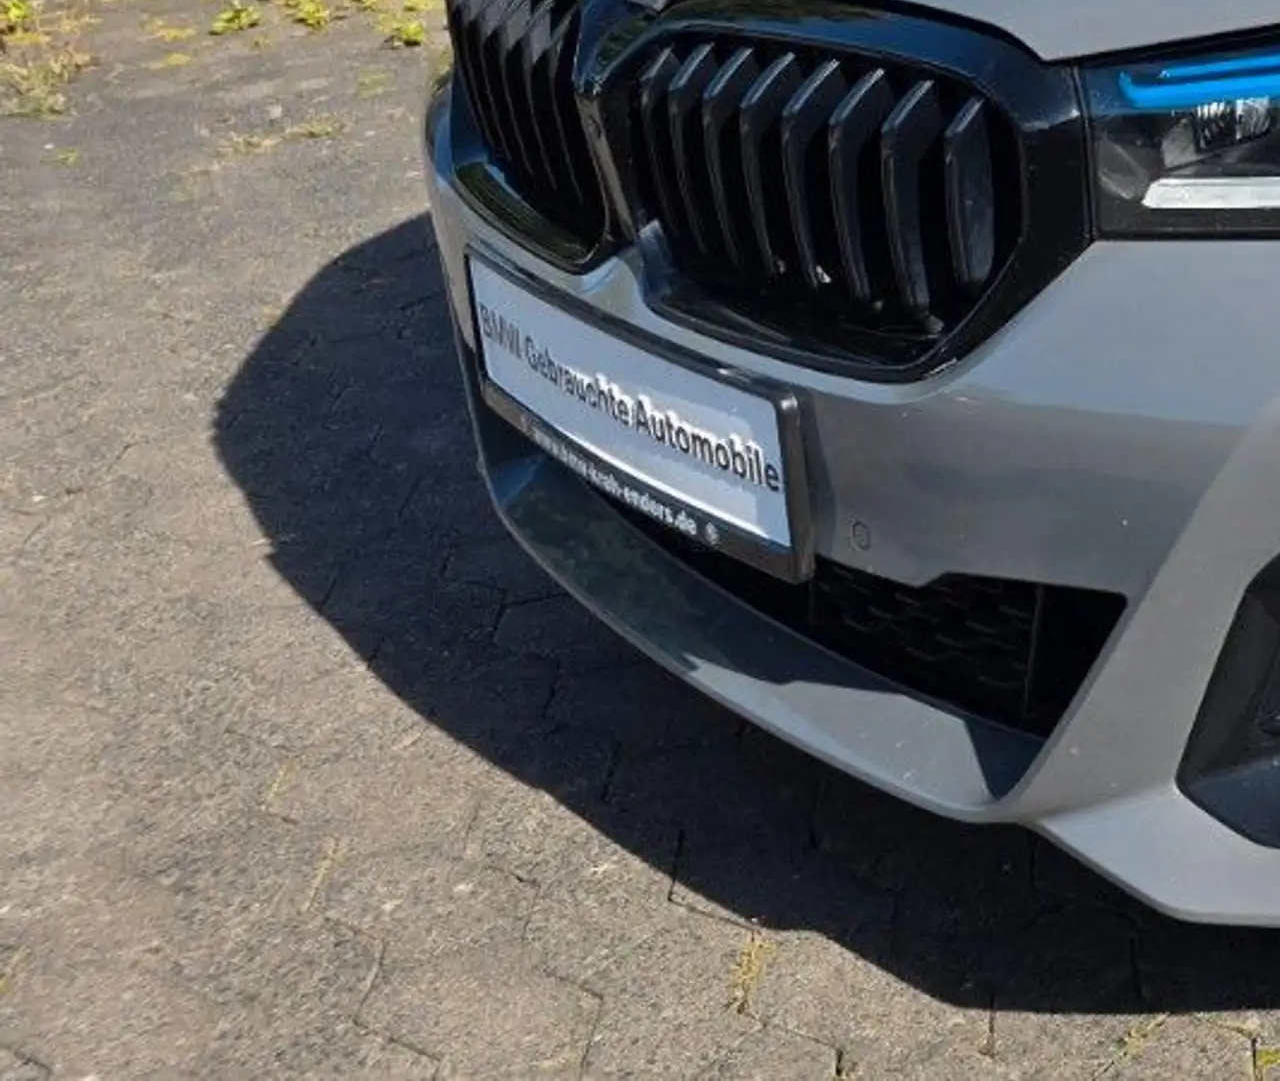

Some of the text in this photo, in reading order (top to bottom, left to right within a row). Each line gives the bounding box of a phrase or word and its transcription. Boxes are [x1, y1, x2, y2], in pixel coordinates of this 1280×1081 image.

[480, 302, 780, 492] BMW Gebrauchte Automobile
